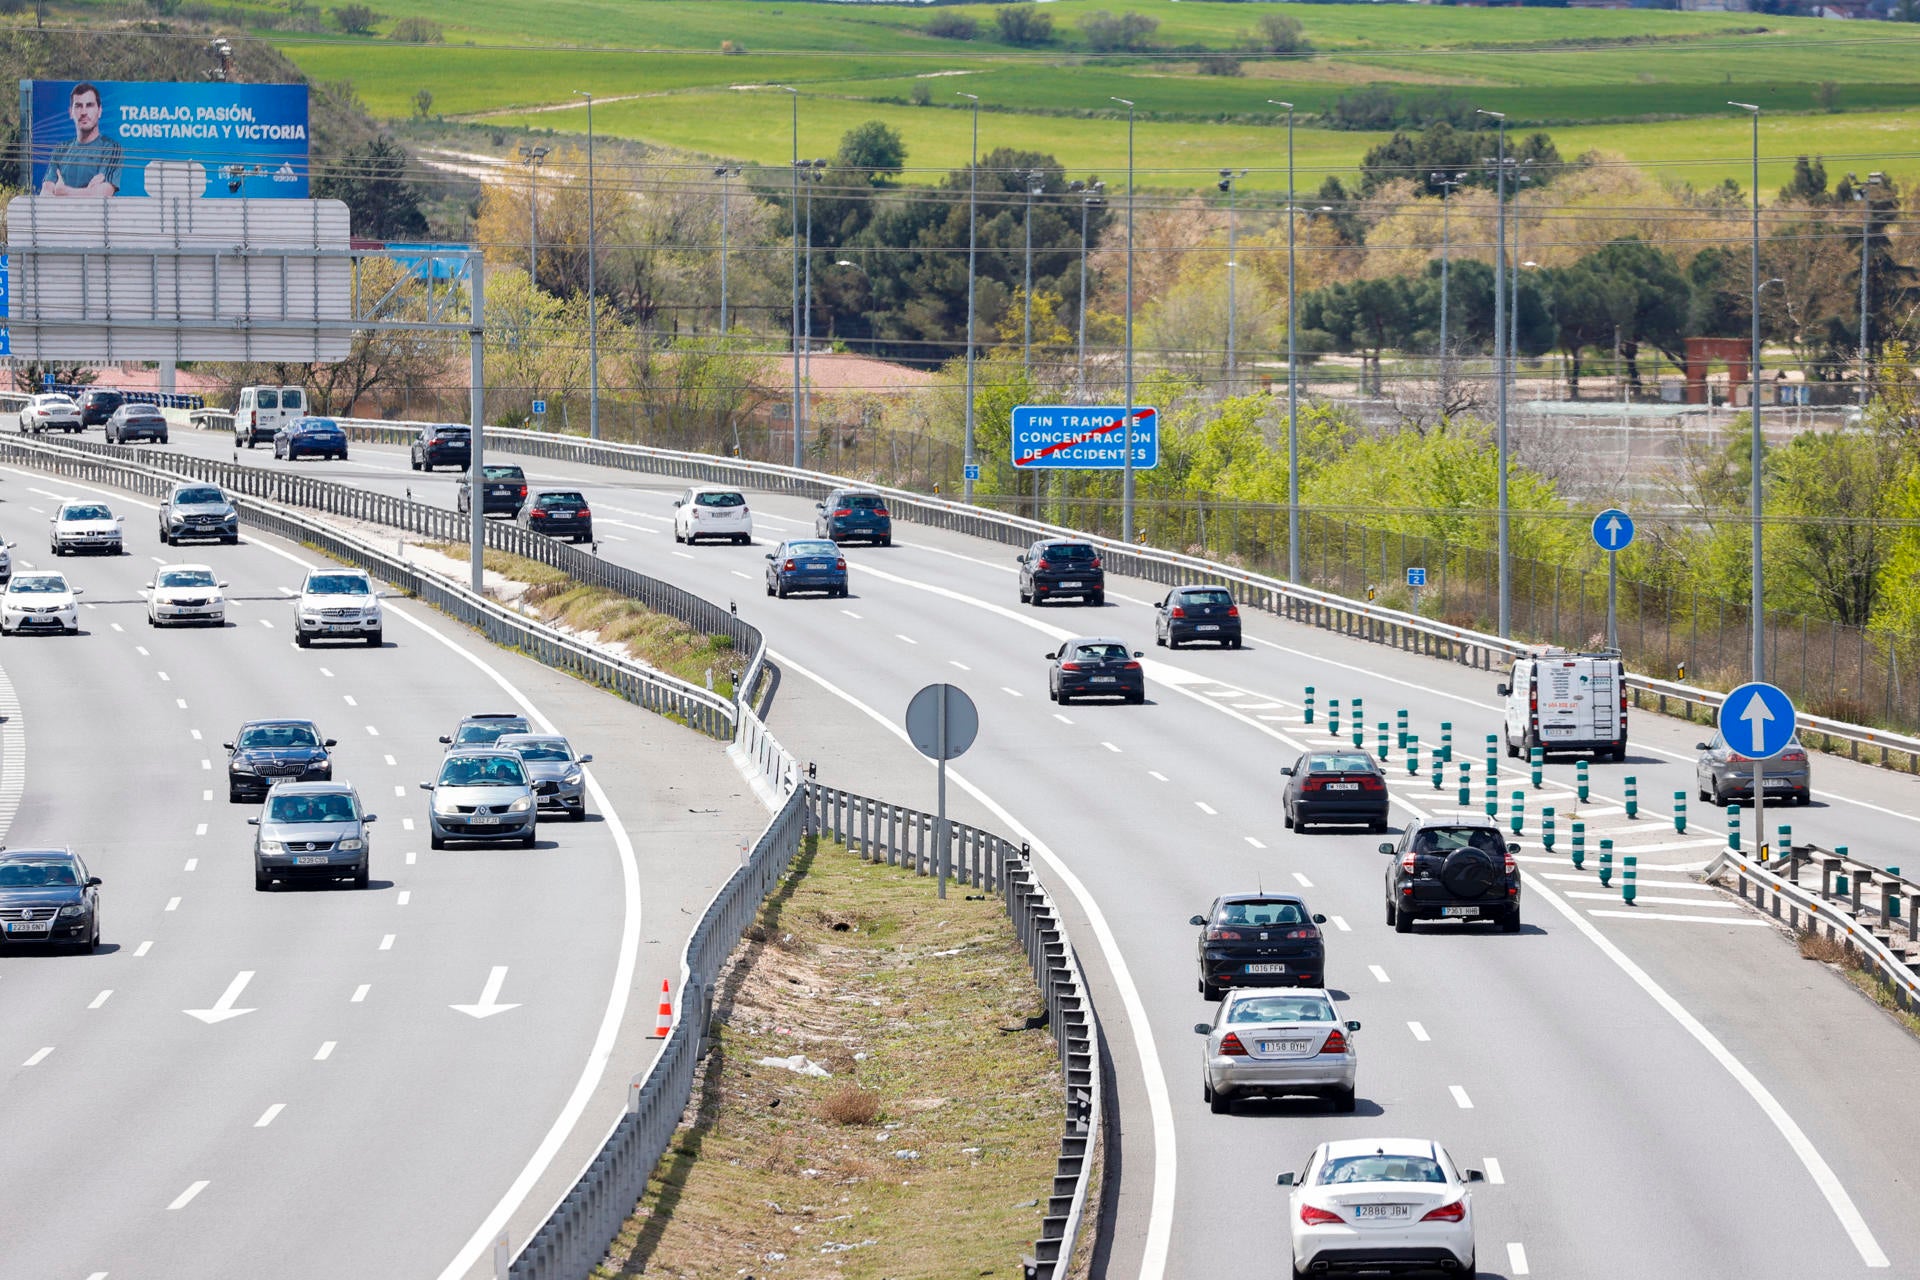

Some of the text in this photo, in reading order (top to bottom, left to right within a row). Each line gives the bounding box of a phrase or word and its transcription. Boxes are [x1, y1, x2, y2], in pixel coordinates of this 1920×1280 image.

[120, 104, 256, 123] TRABAJO, PASIÓN,
[119, 123, 306, 140] CONSTANCIA Y VICTORIA
[1029, 416, 1053, 427] FIN
[1061, 416, 1114, 427] TRAMO
[1020, 431, 1151, 443] CONCENTRACÓN
[1023, 449, 1043, 460] DE
[1251, 964, 1268, 972] 1016
[1266, 1043, 1286, 1051] 1158
[1361, 1206, 1408, 1216] 2886 JBM
